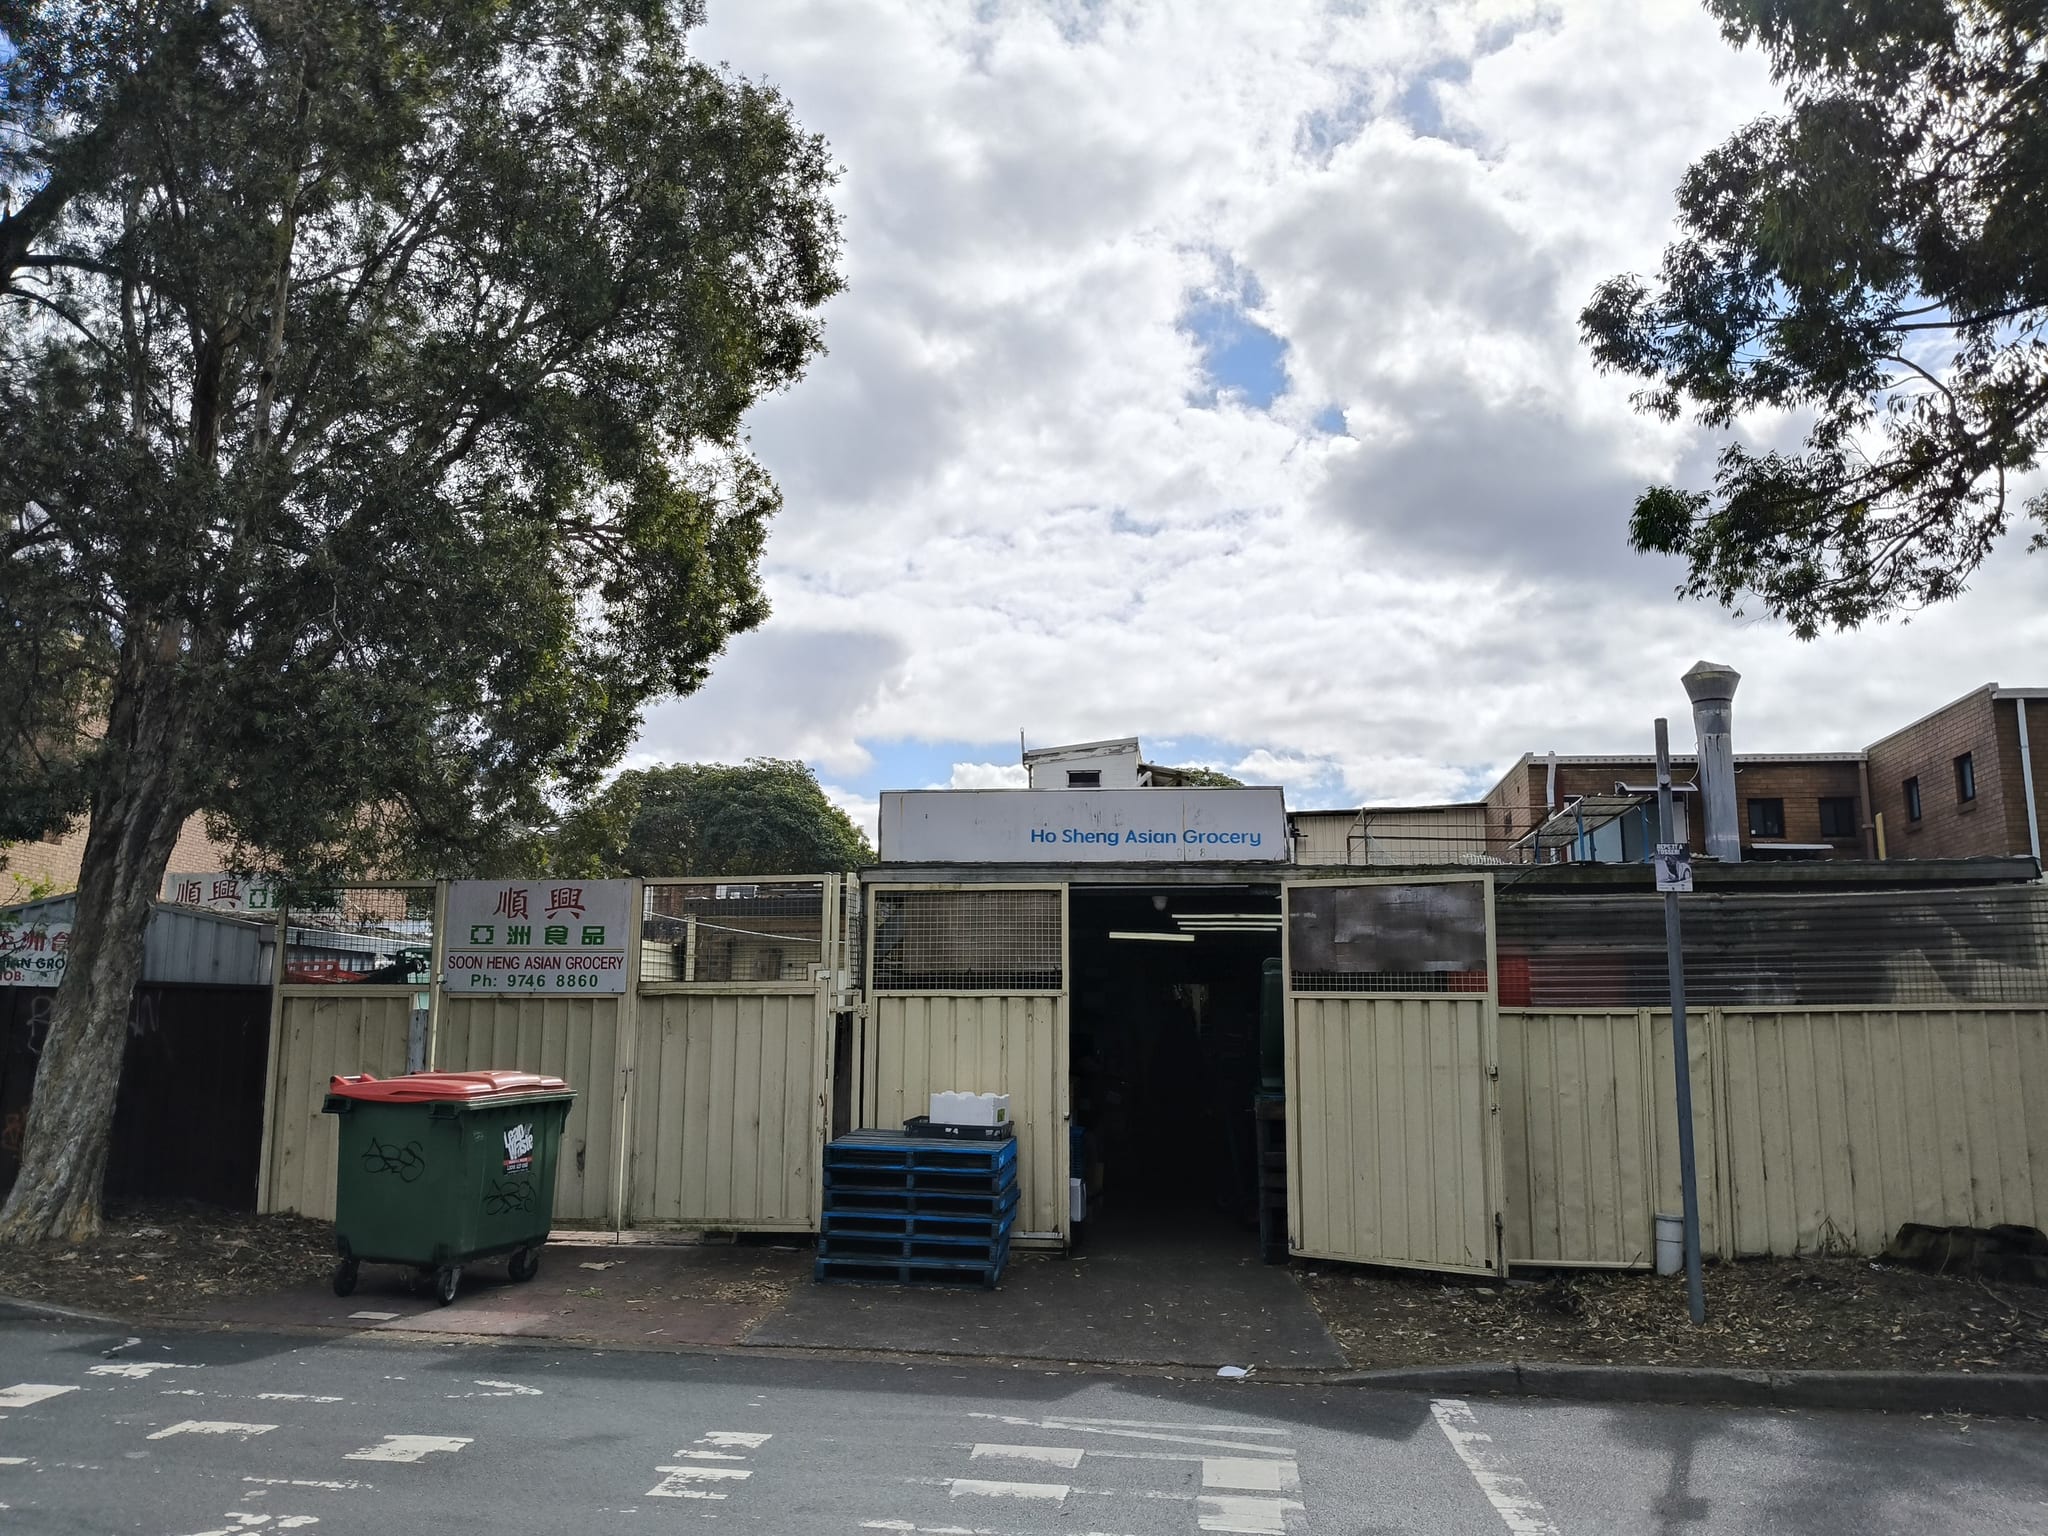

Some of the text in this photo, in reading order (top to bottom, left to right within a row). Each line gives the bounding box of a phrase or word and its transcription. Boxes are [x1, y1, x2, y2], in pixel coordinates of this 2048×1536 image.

[1031, 828, 1262, 846] Ho Sheng Asian Grocery
[492, 886, 586, 920] 順興
[469, 924, 606, 946] 亞洲食品
[448, 955, 624, 970] SOON HENG ASIAN GROCERY
[0, 970, 25, 982] OB:
[470, 973, 599, 988] Ph: 9746 8860
